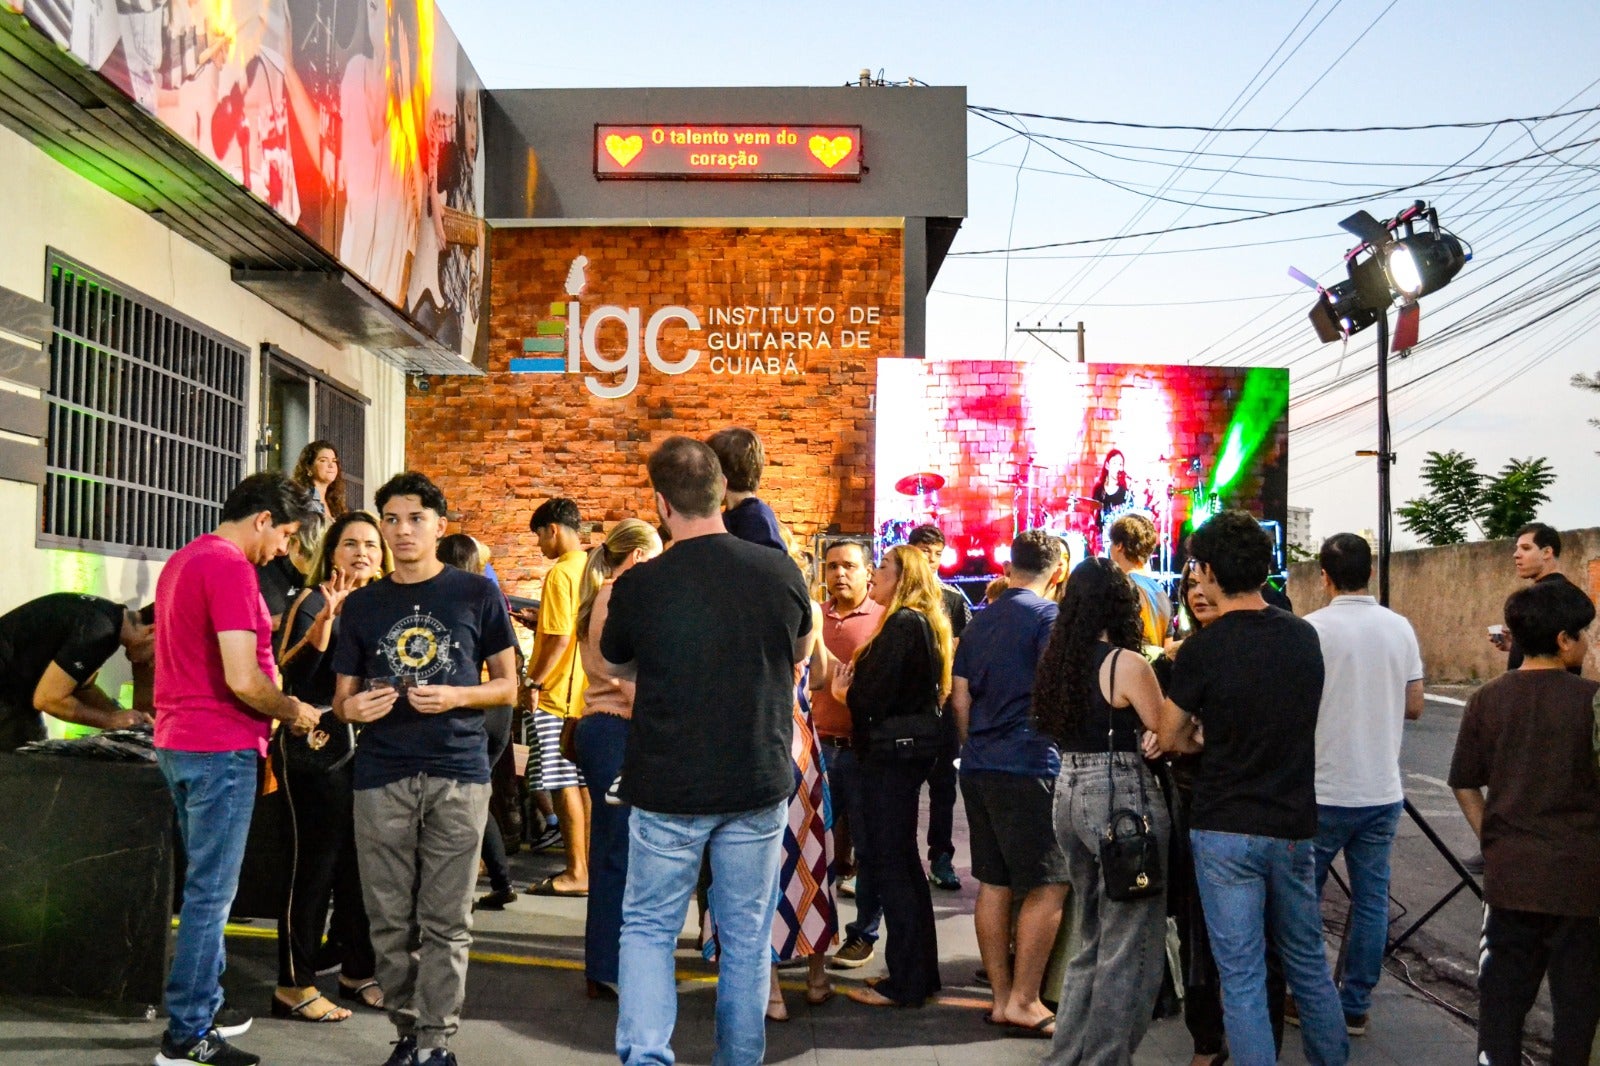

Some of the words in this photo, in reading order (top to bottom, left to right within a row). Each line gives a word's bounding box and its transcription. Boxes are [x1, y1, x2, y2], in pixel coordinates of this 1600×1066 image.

[651, 129, 665, 145] O
[670, 129, 729, 145] talento
[735, 132, 771, 145] vem
[776, 129, 798, 145] do
[690, 151, 759, 169] coração
[708, 307, 836, 326] INSTITUTO
[850, 307, 881, 325] DE
[564, 255, 701, 399] igc
[707, 332, 832, 351] GUITARRA
[840, 331, 871, 349] DE
